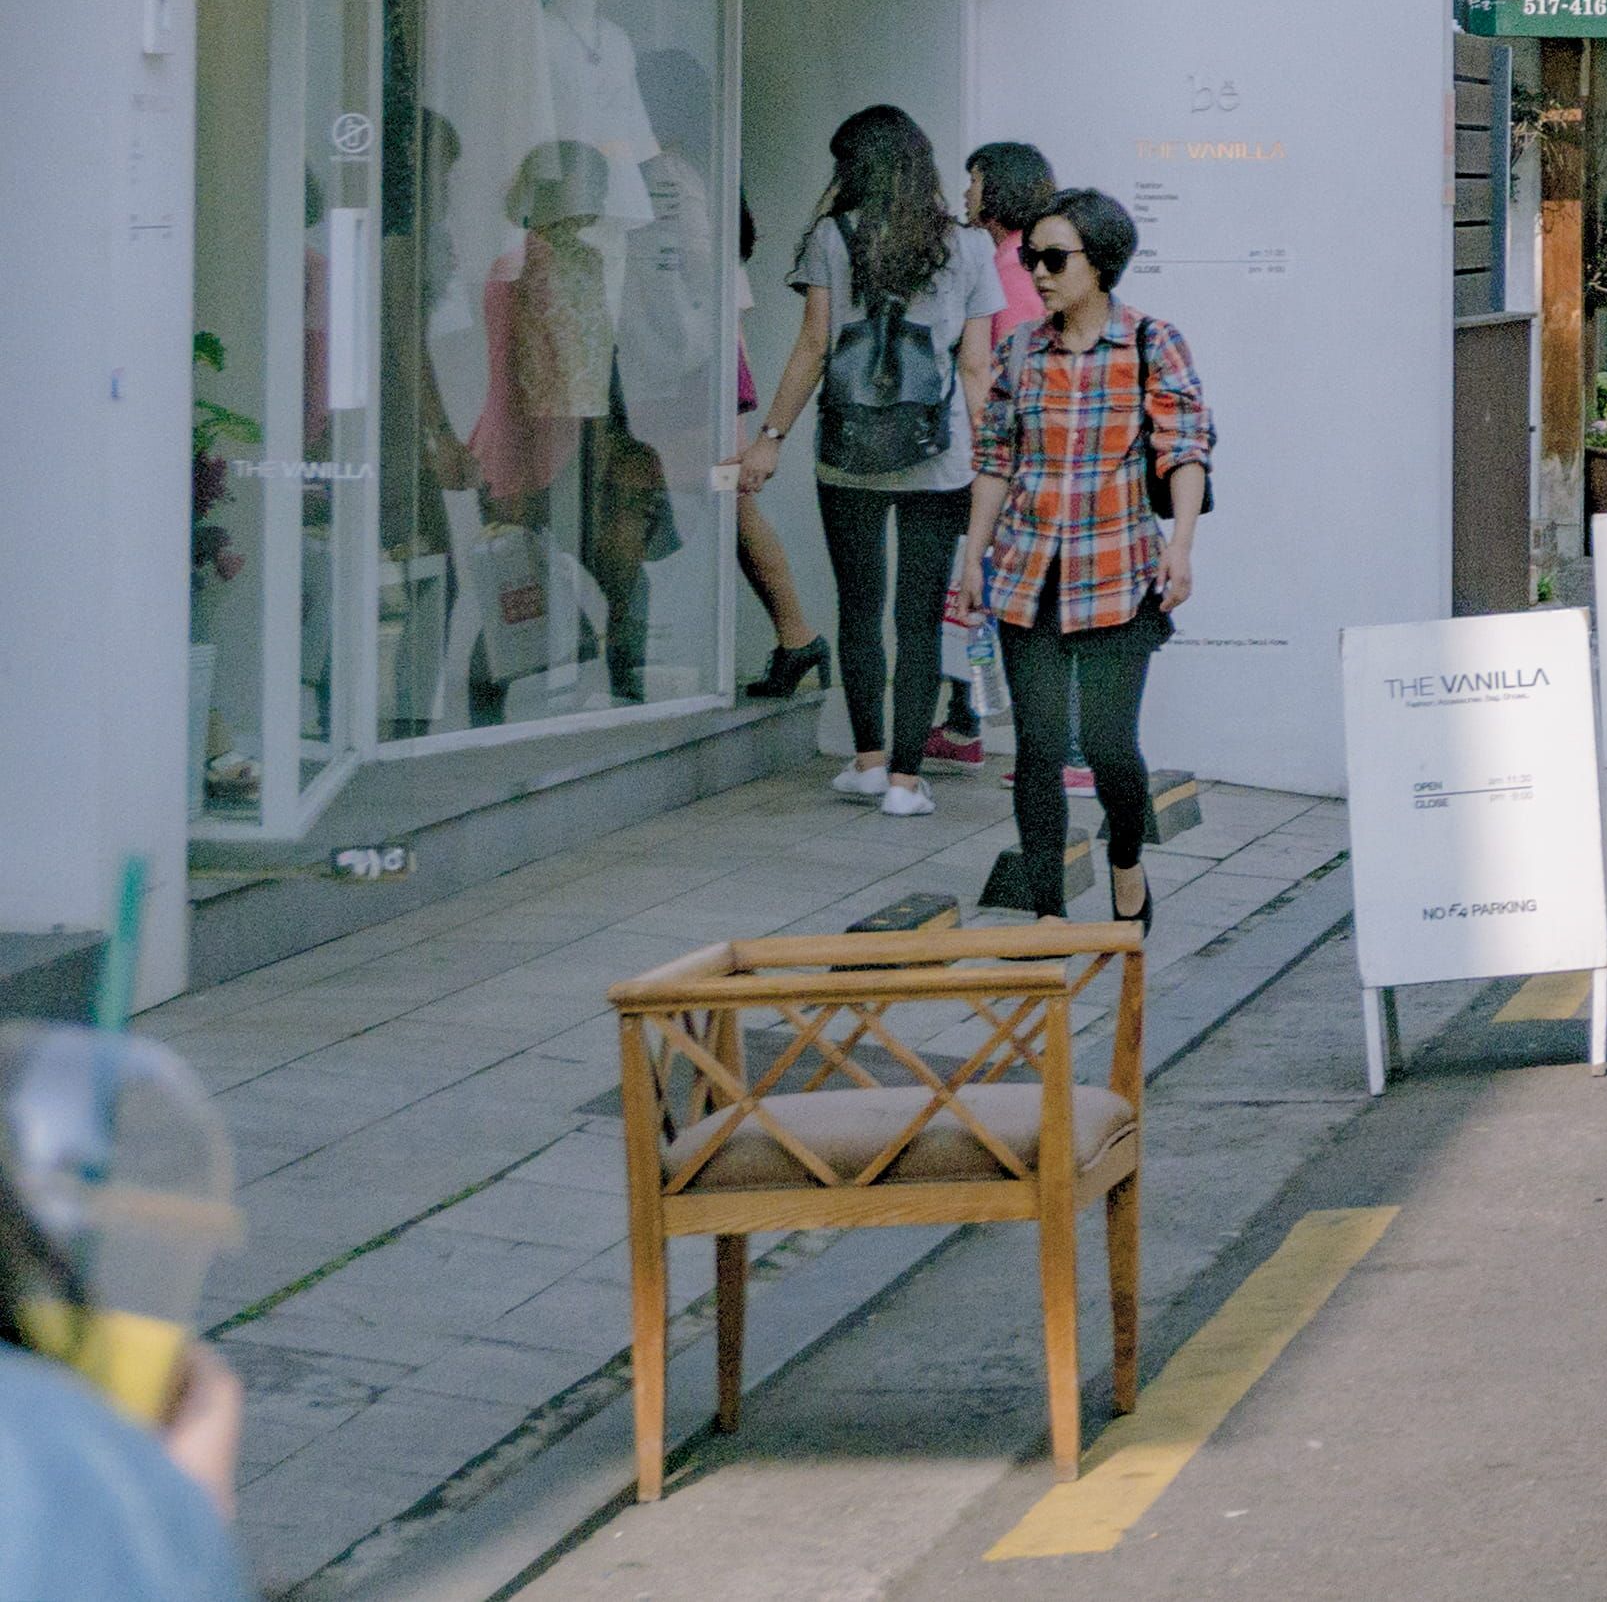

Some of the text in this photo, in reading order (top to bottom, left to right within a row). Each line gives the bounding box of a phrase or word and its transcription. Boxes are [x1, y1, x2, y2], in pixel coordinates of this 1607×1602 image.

[1185, 141, 1287, 160] VANILLA
[231, 460, 375, 479] THE VANILLA
[1384, 667, 1551, 700] THE VANILLA
[1422, 899, 1538, 922] NO PARKING
